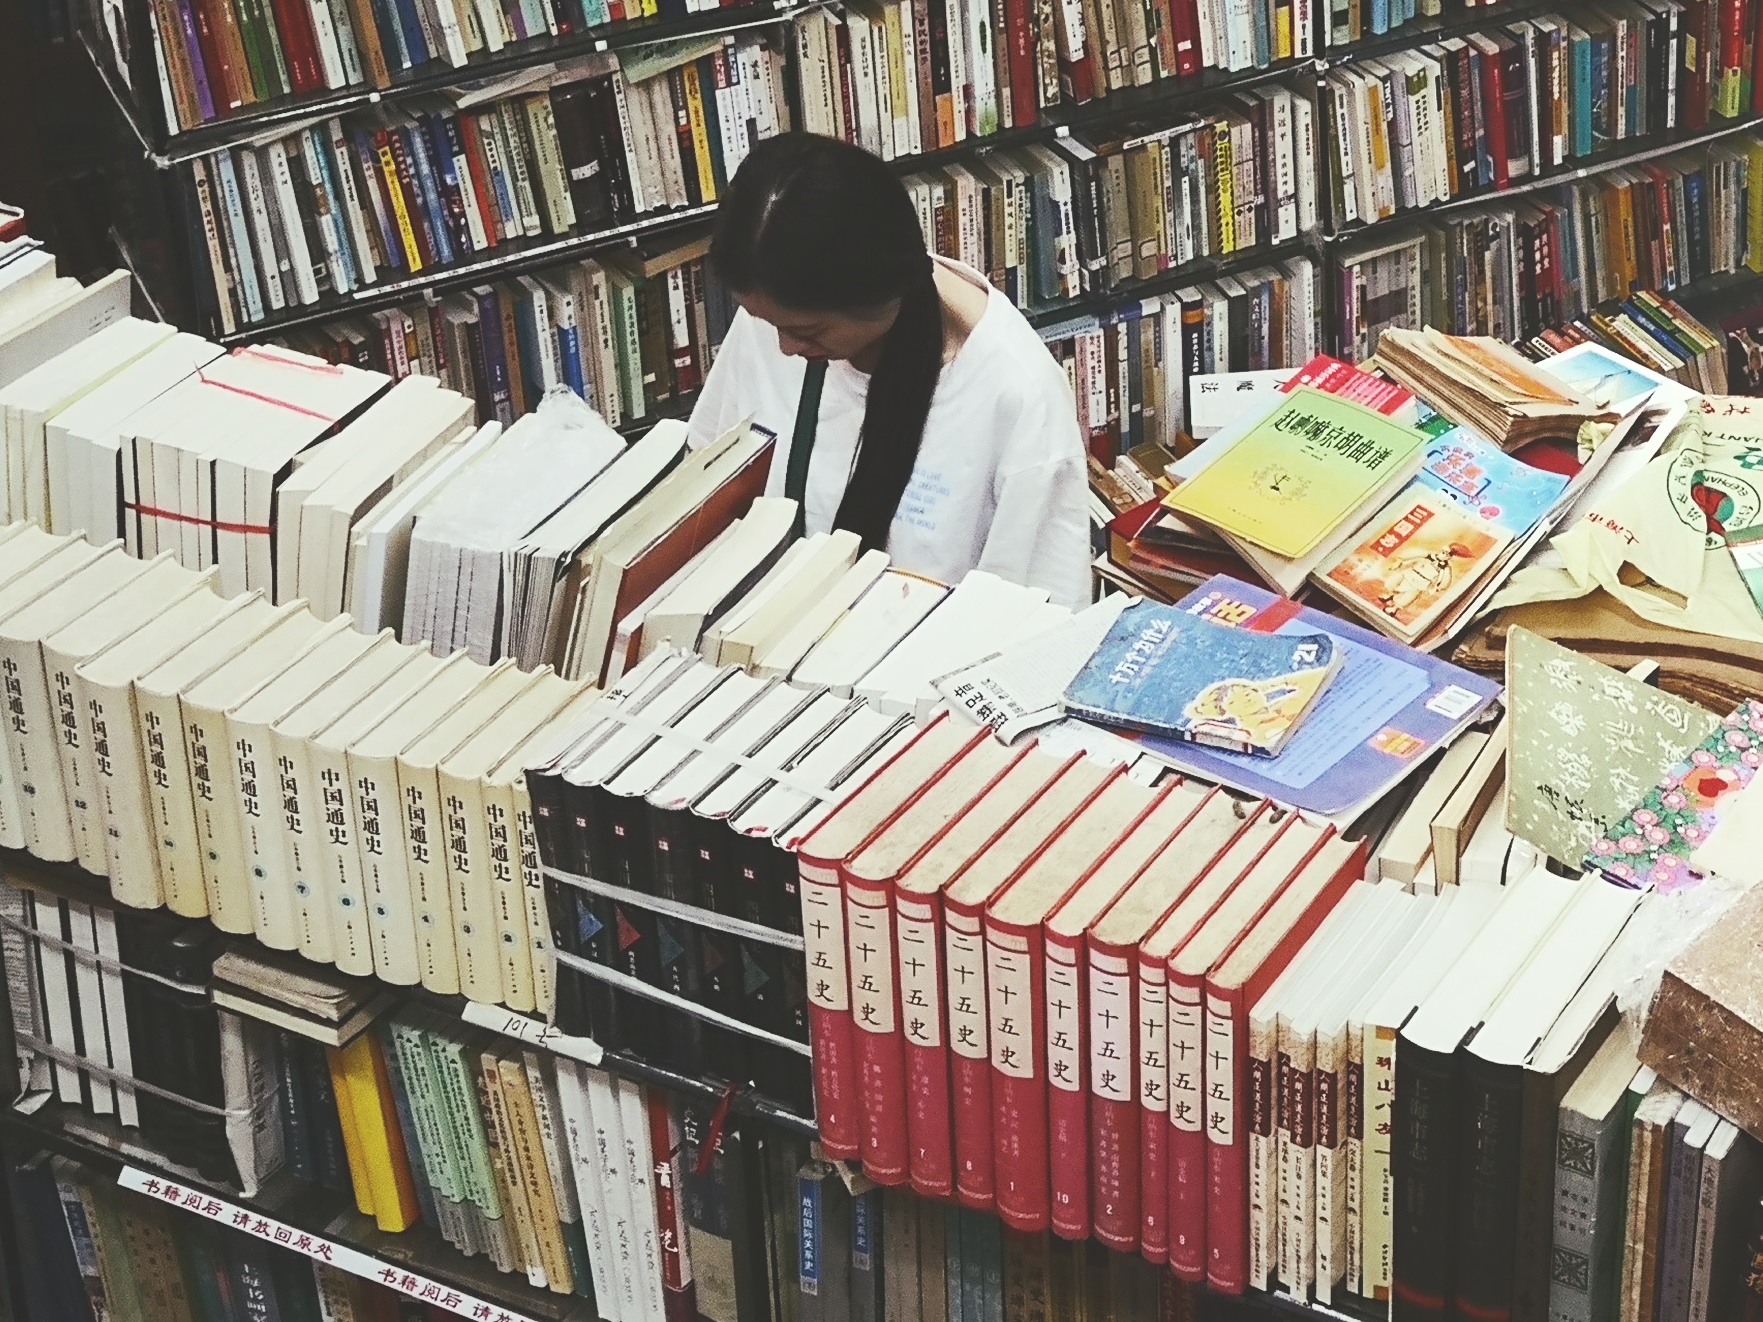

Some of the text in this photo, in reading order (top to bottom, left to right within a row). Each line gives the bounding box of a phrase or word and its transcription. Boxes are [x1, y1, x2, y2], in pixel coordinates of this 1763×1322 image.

[2, 657, 28, 735] 中国通史
[55, 670, 80, 749] 中国通史
[88, 698, 113, 776] 中国通史
[144, 711, 170, 789] 中国通史
[189, 723, 214, 801] 中国通史
[236, 739, 261, 817] 中国通史
[278, 756, 302, 834] 中国通史
[321, 768, 349, 845] 中国通史
[358, 777, 383, 855] 中国通史
[406, 785, 430, 864] 中国通史
[447, 795, 470, 874] 中国通史
[487, 804, 511, 882] 中国通史
[517, 810, 541, 889] 中国通史
[806, 889, 834, 1004] 二十五史
[853, 914, 877, 1026] 二十五史
[902, 929, 931, 1041] 二十五史
[951, 937, 979, 1049] 二十五史
[995, 955, 1022, 1069] 二十五史
[1049, 970, 1075, 1083] 二十五史
[1096, 981, 1121, 1092] 二十五史
[1141, 988, 1166, 1104] 二十五史
[1171, 1009, 1198, 1125] 二十五史
[1207, 1019, 1228, 1135] 二十五史
[139, 1176, 224, 1220] 书籍阅后
[229, 1209, 336, 1263] 请放回原处
[375, 1264, 464, 1310] 书籍阅后
